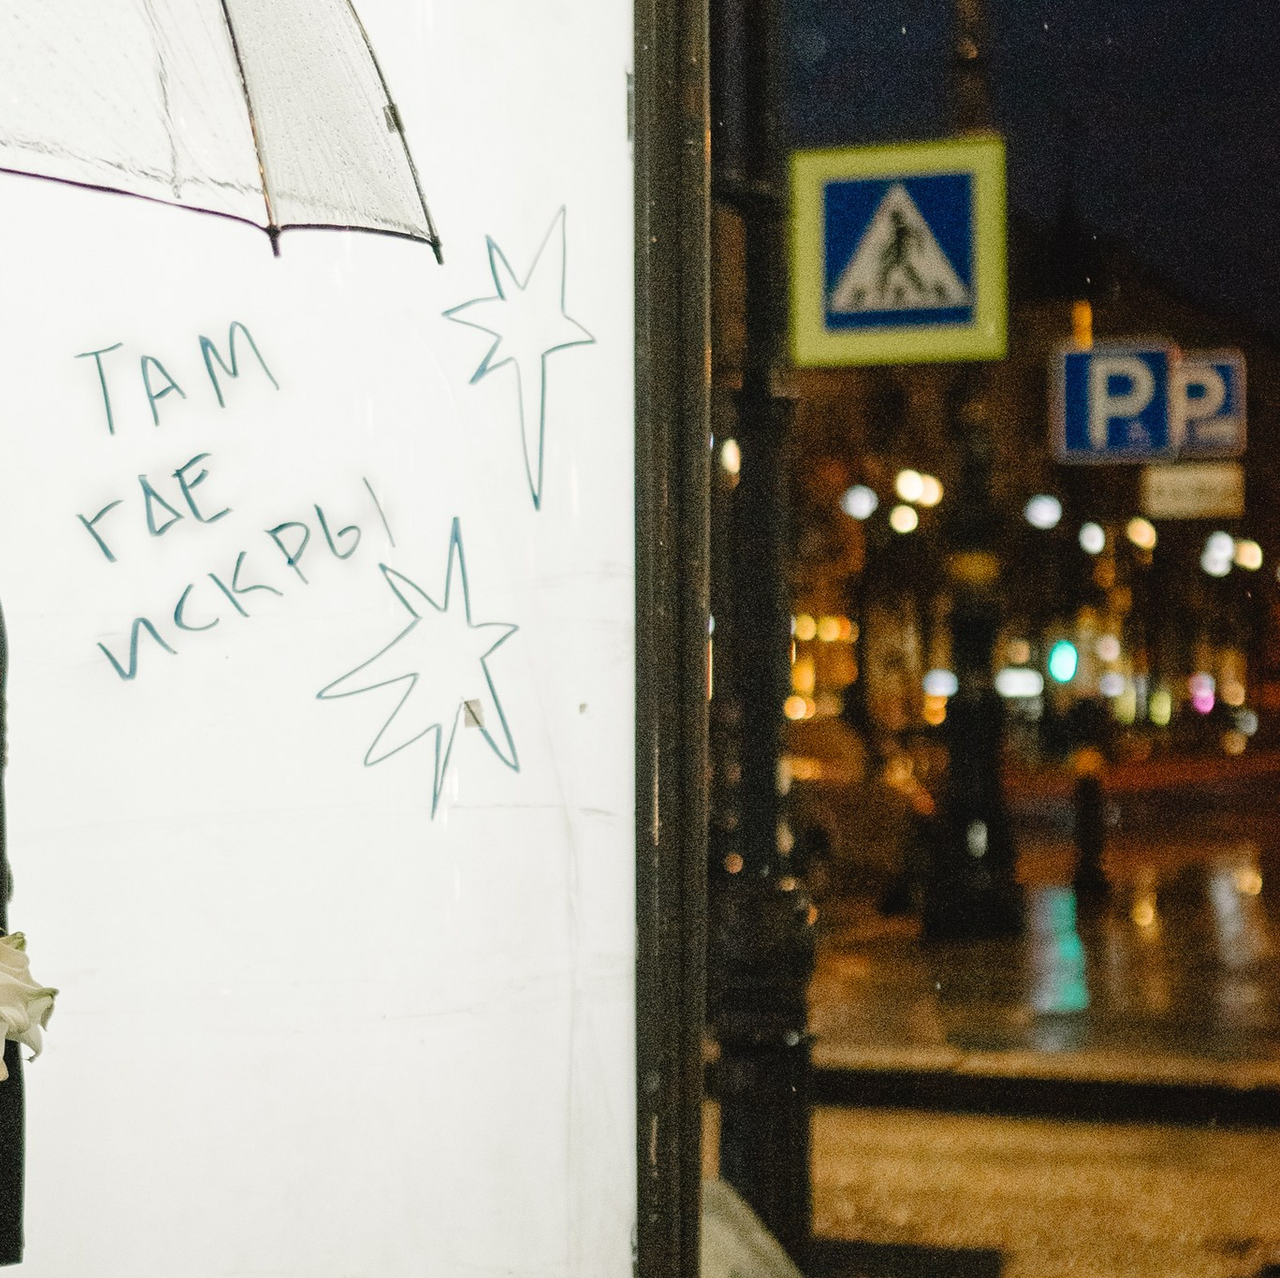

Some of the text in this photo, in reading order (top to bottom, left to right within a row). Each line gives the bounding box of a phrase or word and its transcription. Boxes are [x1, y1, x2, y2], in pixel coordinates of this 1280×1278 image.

[75, 321, 280, 435] ТАМ
[1089, 356, 1155, 450] P
[1172, 364, 1226, 448] P
[77, 453, 232, 562] ГДЕ
[97, 477, 395, 680] ИСКРЫ
